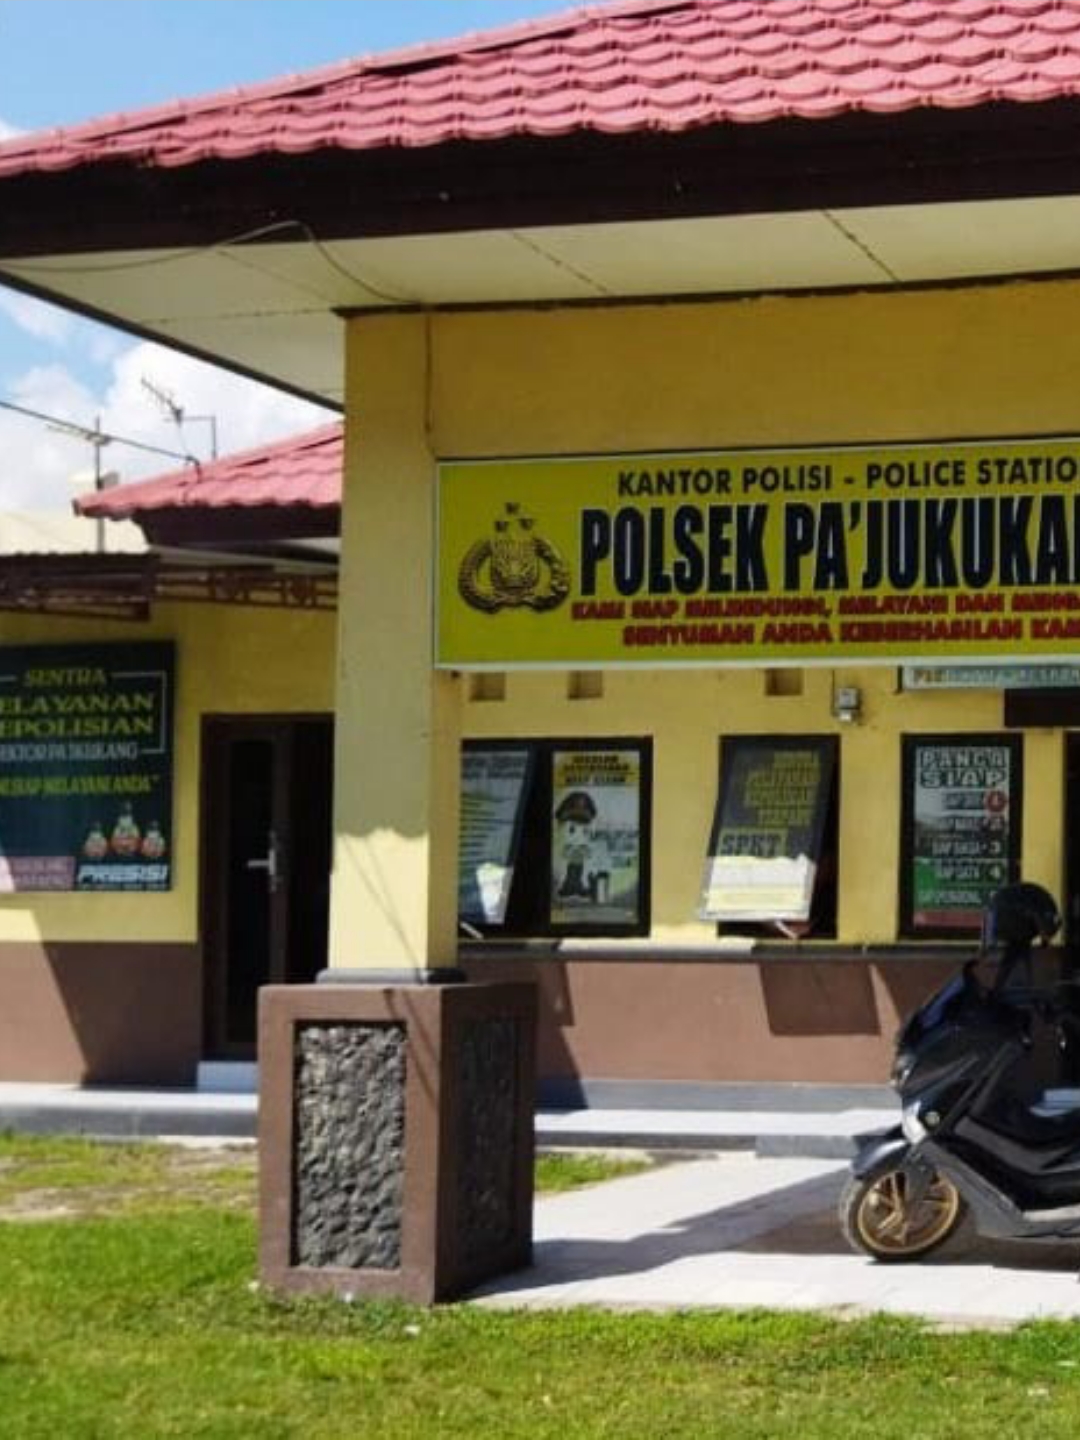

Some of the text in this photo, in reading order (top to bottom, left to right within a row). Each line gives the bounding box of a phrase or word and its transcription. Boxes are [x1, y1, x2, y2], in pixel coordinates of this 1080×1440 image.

[617, 468, 731, 496] KANTOR
[743, 465, 832, 492] POLISI
[866, 461, 965, 489] POLICE
[581, 503, 769, 596] POLSEK
[955, 593, 1005, 612] DAN
[623, 625, 755, 645] SENYUMAN
[762, 623, 833, 643] ANDA
[839, 620, 1023, 642] KEBERHASILAN
[922, 770, 1004, 788] SIAP
[722, 832, 780, 857] SPKT
